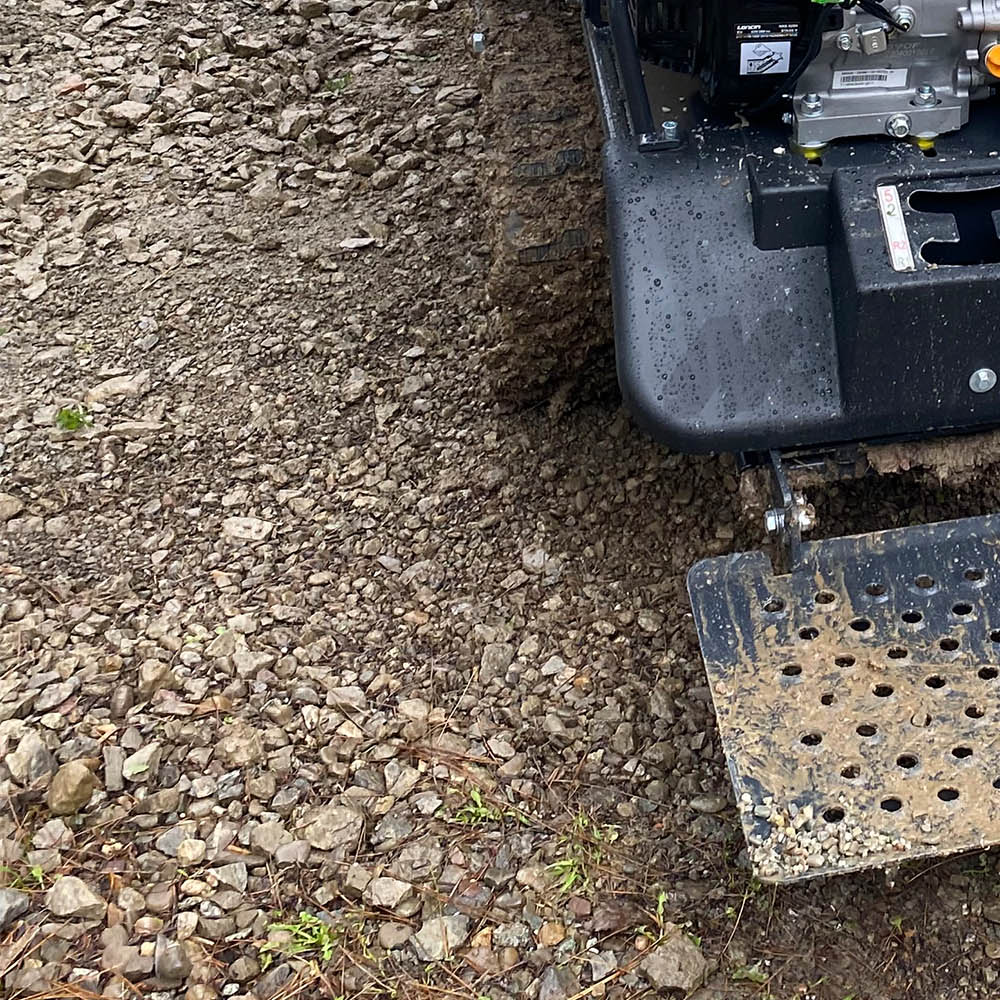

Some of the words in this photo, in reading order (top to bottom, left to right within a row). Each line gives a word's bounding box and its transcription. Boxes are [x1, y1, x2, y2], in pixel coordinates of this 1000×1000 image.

[884, 189, 893, 202] 5
[887, 203, 896, 216] 2
[892, 240, 907, 250] R2
